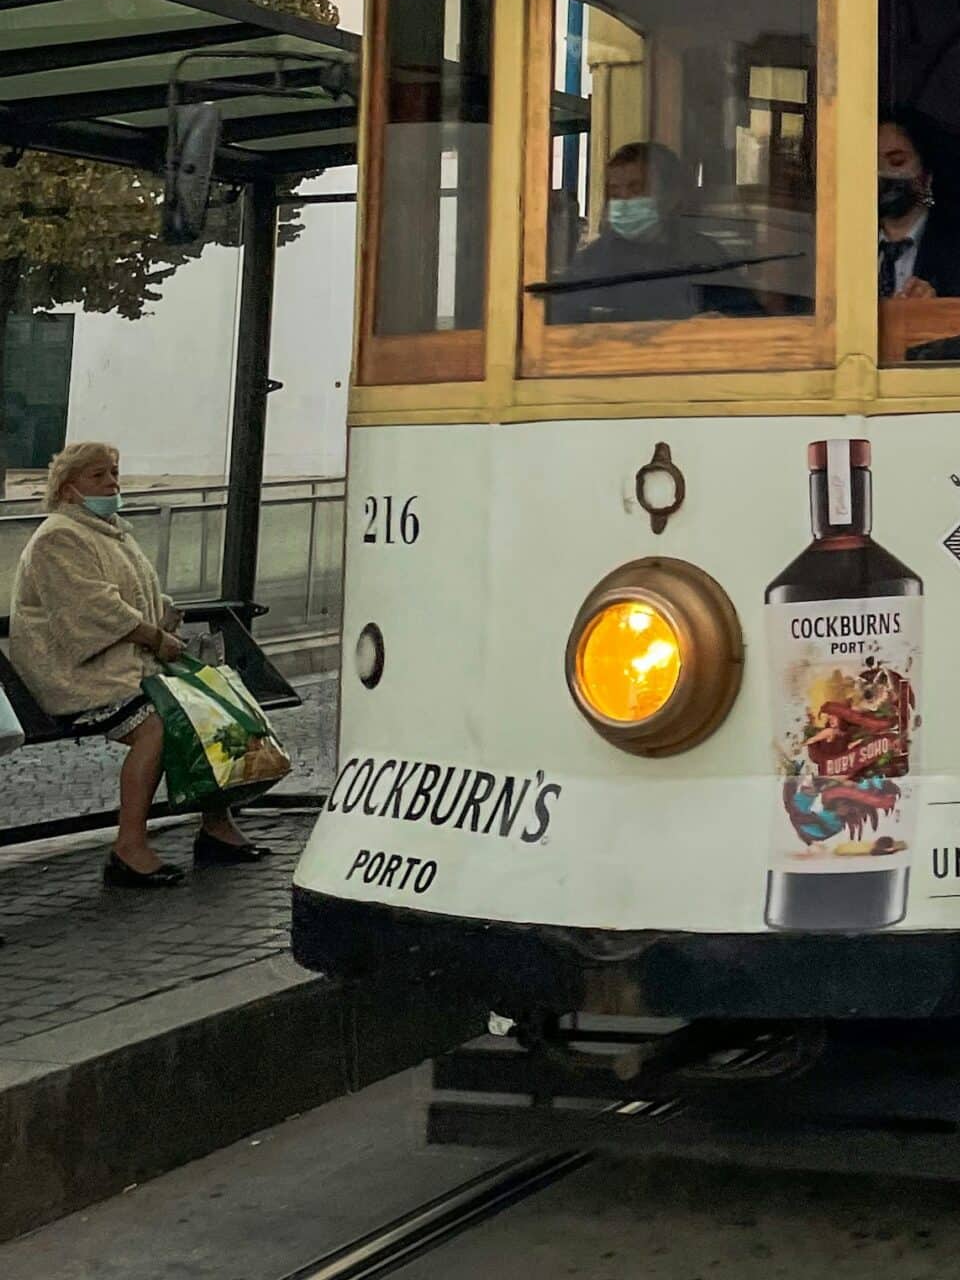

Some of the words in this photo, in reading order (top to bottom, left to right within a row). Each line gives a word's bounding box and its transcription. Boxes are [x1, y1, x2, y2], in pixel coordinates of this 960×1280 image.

[363, 495, 420, 545] 216
[830, 641, 865, 655] PORT
[326, 757, 563, 843] COCKBURN'S
[345, 848, 438, 894] PORTO
